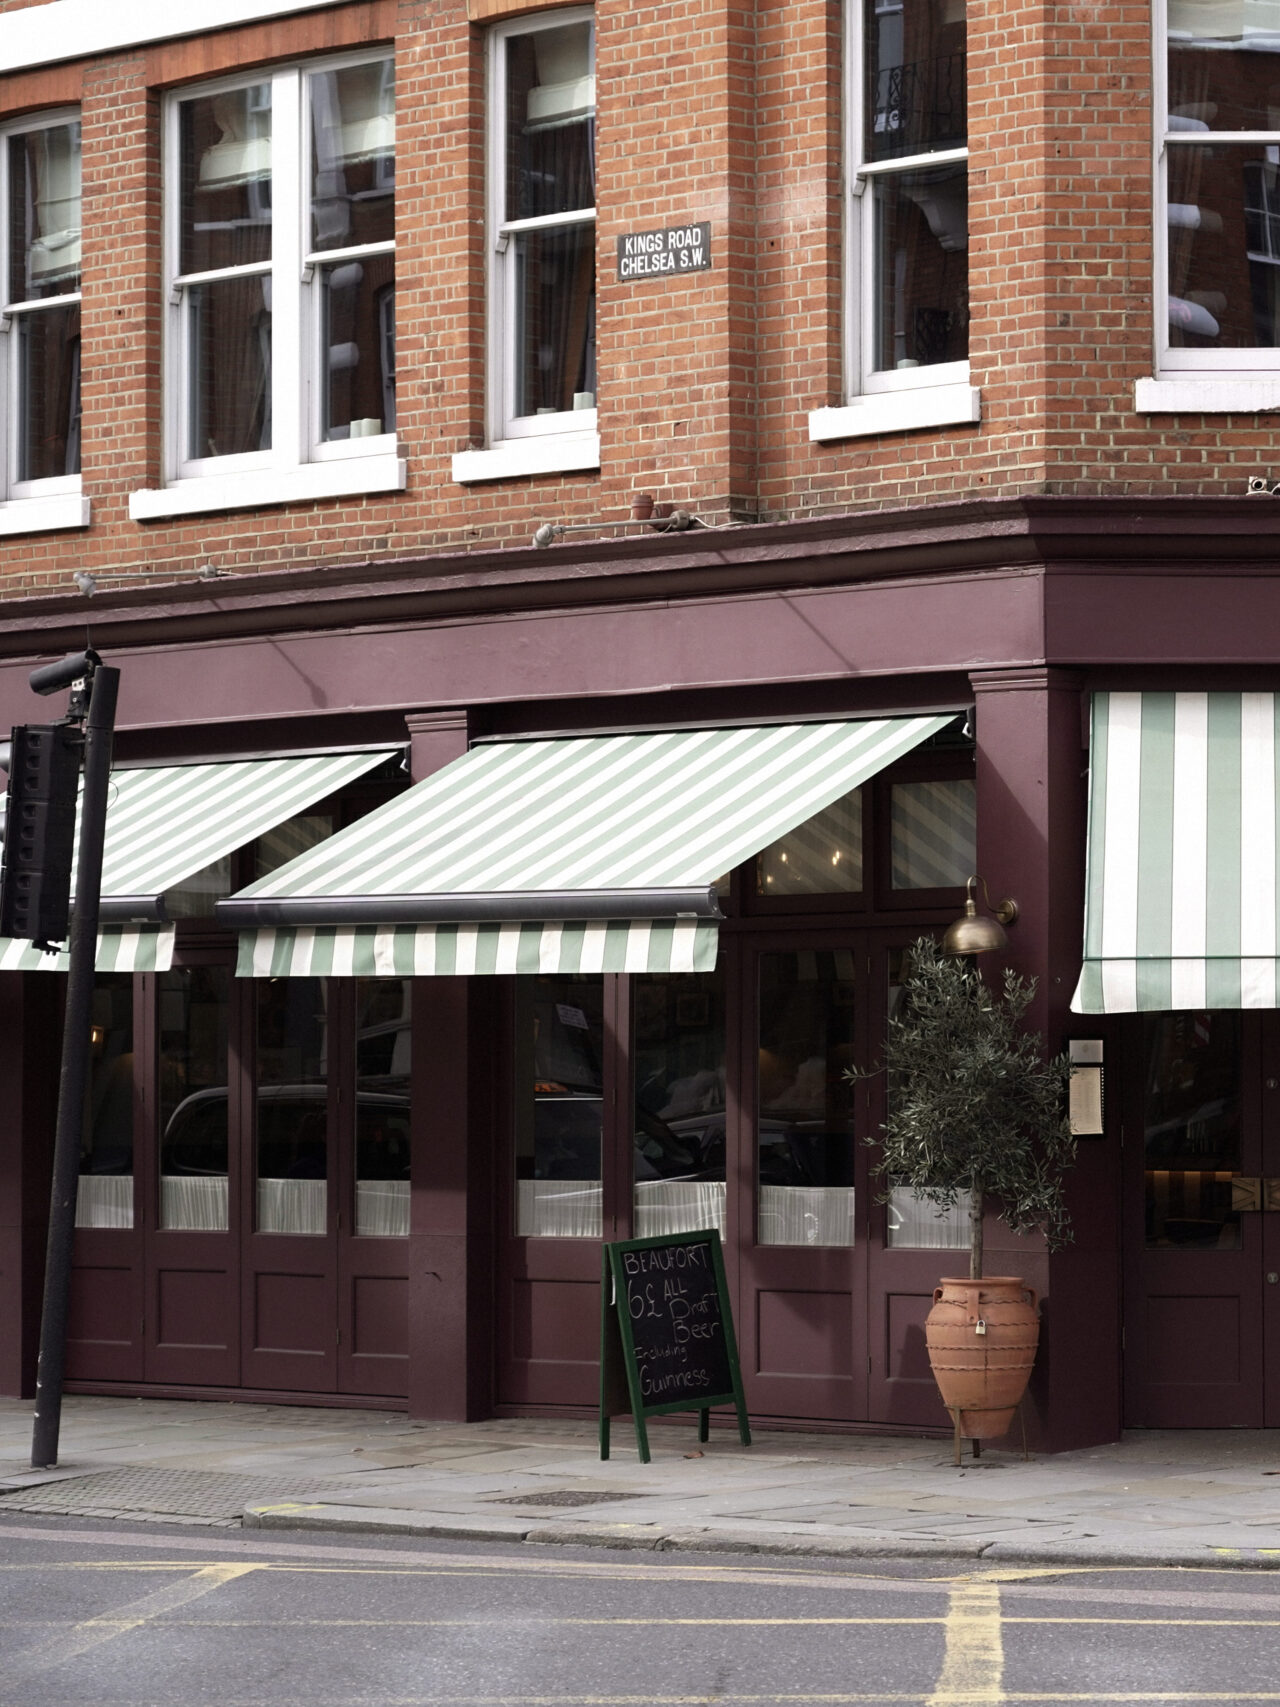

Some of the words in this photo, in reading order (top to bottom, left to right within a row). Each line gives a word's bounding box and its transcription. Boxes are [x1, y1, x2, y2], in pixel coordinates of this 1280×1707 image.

[625, 233, 663, 255] KINGS
[668, 228, 701, 249] ROAD
[621, 252, 675, 275] CHELSEA
[680, 247, 706, 267] S.W.
[624, 1243, 709, 1274] BEAUFORT
[664, 1277, 688, 1300] ALL
[673, 1320, 720, 1343] Beer
[633, 1347, 688, 1362] Including
[639, 1364, 711, 1396] Guinness
